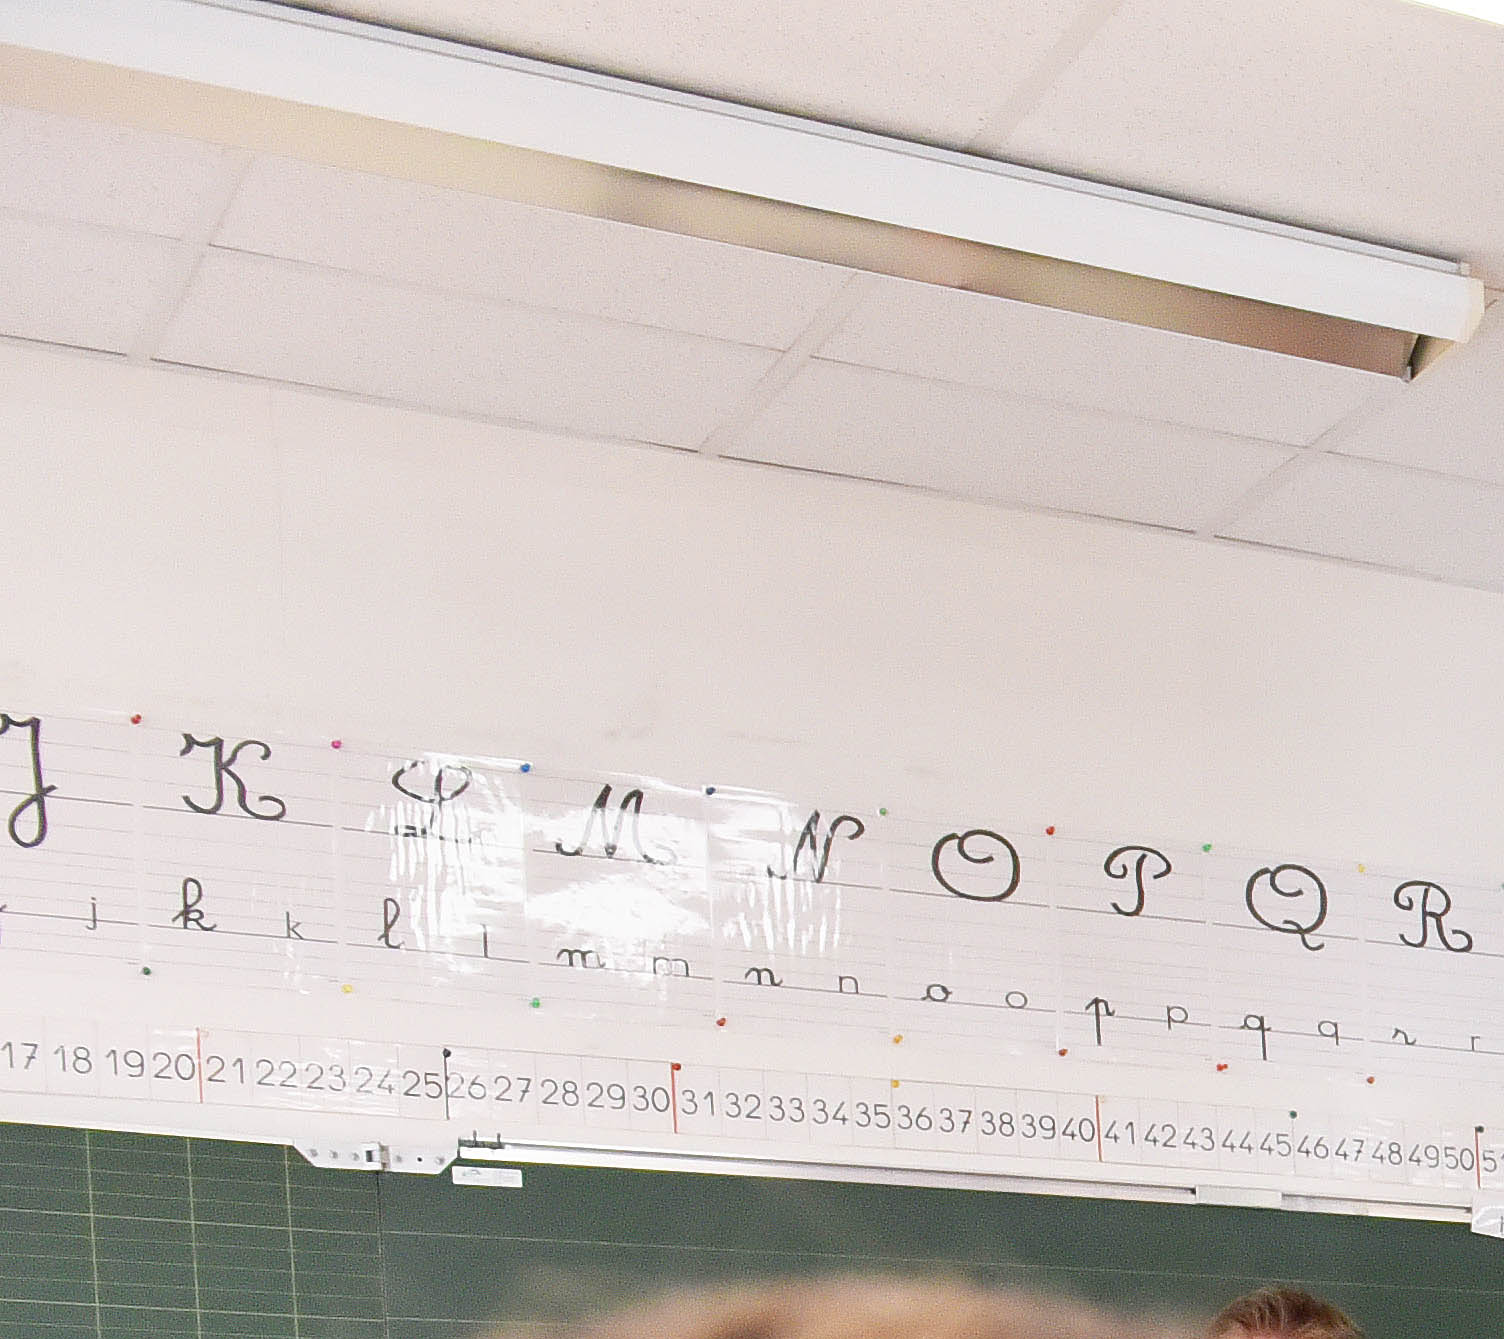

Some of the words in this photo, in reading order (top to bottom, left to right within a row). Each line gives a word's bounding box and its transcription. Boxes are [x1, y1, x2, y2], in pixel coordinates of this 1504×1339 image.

[180, 733, 288, 822] K
[556, 784, 677, 866] M
[767, 810, 864, 883] N
[932, 829, 1020, 902] O
[1104, 846, 1171, 916] P
[1246, 864, 1327, 951] Q
[1394, 880, 1472, 953] R
[83, 897, 102, 930] j
[170, 877, 218, 932] k
[283, 912, 306, 940] k
[554, 949, 605, 968] m
[743, 967, 785, 988] n
[835, 976, 859, 994] n
[920, 984, 952, 1003] o
[1003, 991, 1028, 1009] o
[1085, 997, 1115, 1046] p
[1167, 1006, 1190, 1030] p
[1237, 1015, 1275, 1061] q
[1315, 1021, 1339, 1046] q
[1, 1042, 38, 1069] 17
[54, 1045, 92, 1074] 18
[106, 1049, 144, 1077] 19
[153, 1052, 195, 1080] 20
[206, 1056, 244, 1084] 21
[256, 1059, 297, 1088] 22
[306, 1066, 347, 1092] 23
[355, 1067, 394, 1094] 24
[402, 1070, 443, 1099] 25
[448, 1073, 486, 1100] 26
[494, 1075, 531, 1102] 27
[541, 1079, 579, 1106] 28
[586, 1082, 625, 1109] 29
[633, 1086, 670, 1112] 30
[682, 1090, 714, 1116] 31
[726, 1092, 762, 1119] 32
[769, 1096, 805, 1123] 33
[812, 1099, 849, 1125] 34
[855, 1102, 891, 1129] 35
[898, 1105, 932, 1131] 36
[939, 1108, 972, 1133] 37
[981, 1111, 1015, 1137] 38
[1022, 1114, 1056, 1140] 39
[1062, 1117, 1095, 1142] 40
[1104, 1120, 1135, 1145] 41
[1144, 1124, 1177, 1148] 42
[1183, 1127, 1215, 1151] 43
[1222, 1129, 1254, 1154] 44
[1260, 1133, 1291, 1157] 45
[1297, 1135, 1329, 1159] 46
[1335, 1138, 1364, 1162] 47
[1372, 1141, 1402, 1165] 48
[1408, 1144, 1439, 1168] 49
[1444, 1146, 1474, 1171] 50
